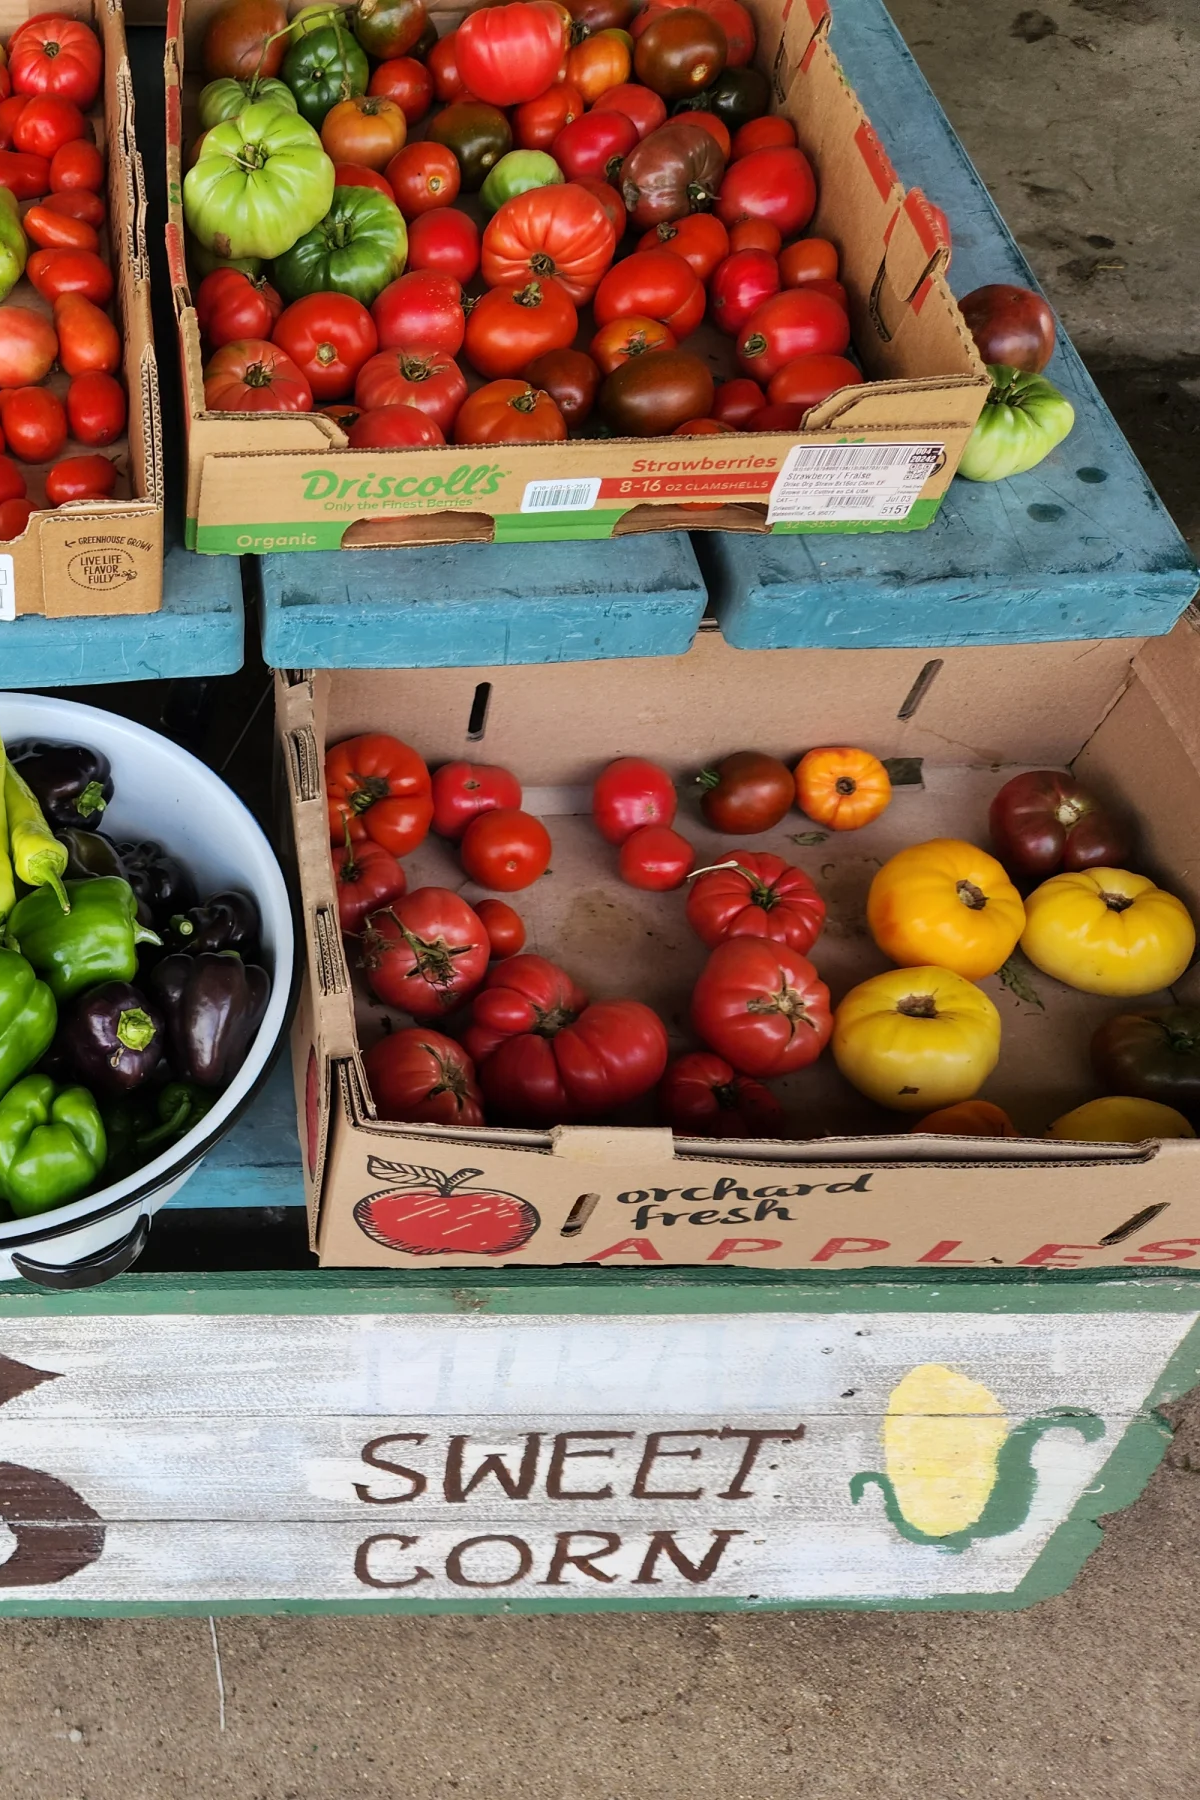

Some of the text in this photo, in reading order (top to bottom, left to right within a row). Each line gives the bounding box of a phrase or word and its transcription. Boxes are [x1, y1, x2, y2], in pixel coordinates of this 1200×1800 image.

[632, 454, 778, 473] Strawberries
[910, 455, 937, 463] 20242
[301, 463, 506, 500] Driscoll's
[787, 472, 834, 481] Strawberry
[843, 471, 871, 479] Fraise
[619, 479, 769, 493] 8-16 OZ CLAMSHELLS
[324, 497, 473, 513] Only the Finest Berries
[881, 505, 910, 514] 5151
[78, 535, 154, 552] GREENHOUSE GROWN
[236, 533, 317, 549] Organic
[80, 554, 122, 566] LIVE LIFE
[83, 564, 119, 575] FLAVOR
[616, 1173, 874, 1205] orchard
[630, 1198, 800, 1231] fresh
[584, 1237, 1200, 1268] APPLES
[353, 1424, 806, 1506] SWEET
[353, 1528, 749, 1591] CORN
